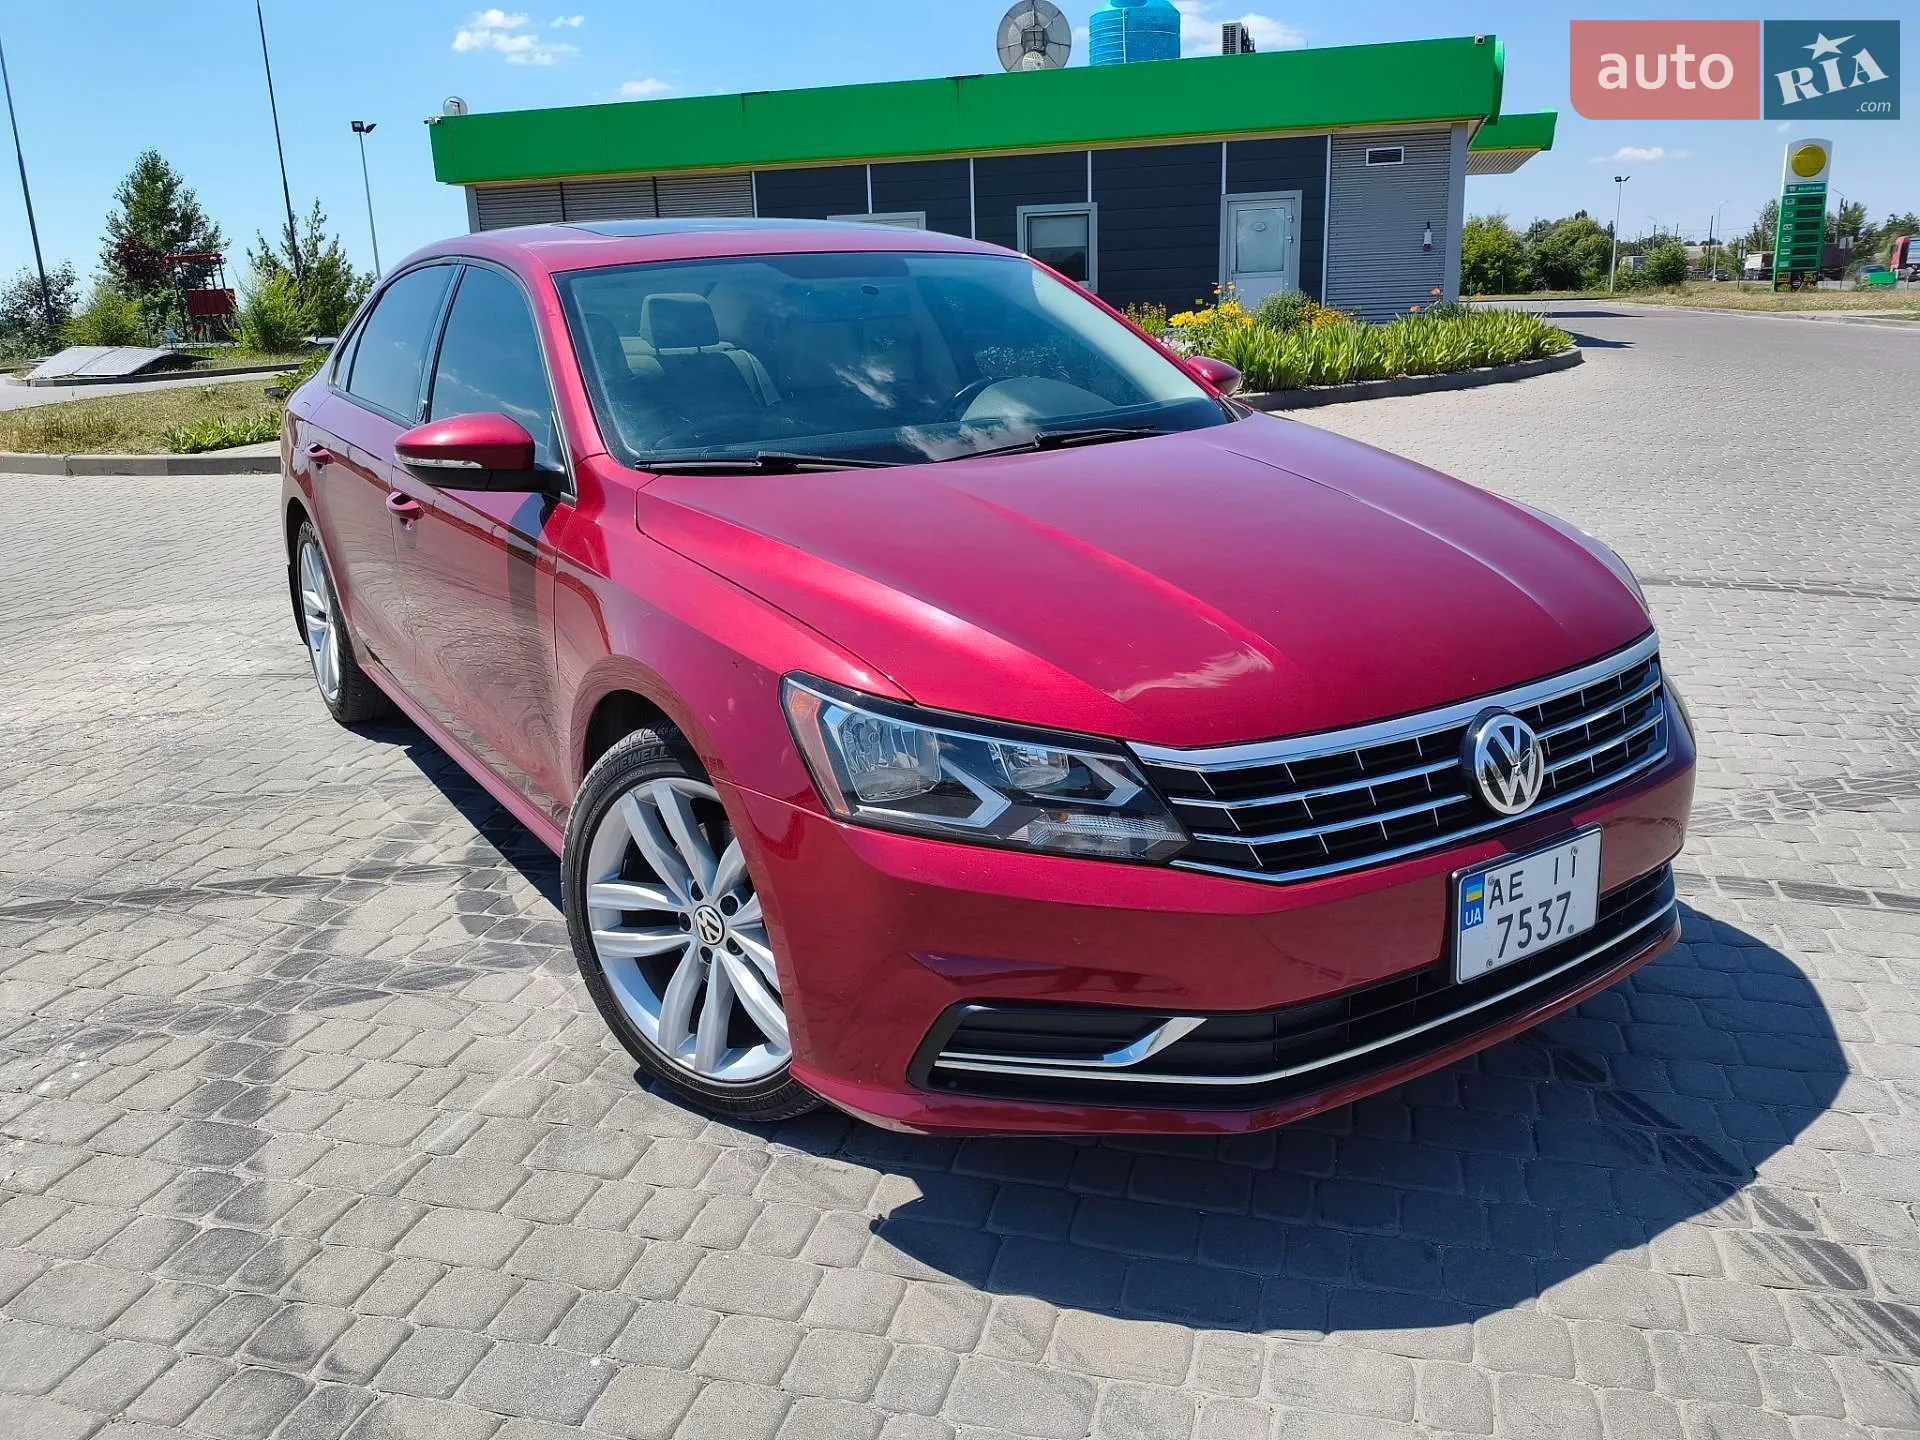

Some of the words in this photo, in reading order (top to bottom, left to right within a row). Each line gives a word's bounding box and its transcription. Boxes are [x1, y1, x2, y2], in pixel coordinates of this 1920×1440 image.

[1488, 870, 1524, 910] AE
[1465, 909, 1482, 926] UA
[1497, 891, 1572, 959] 7537
